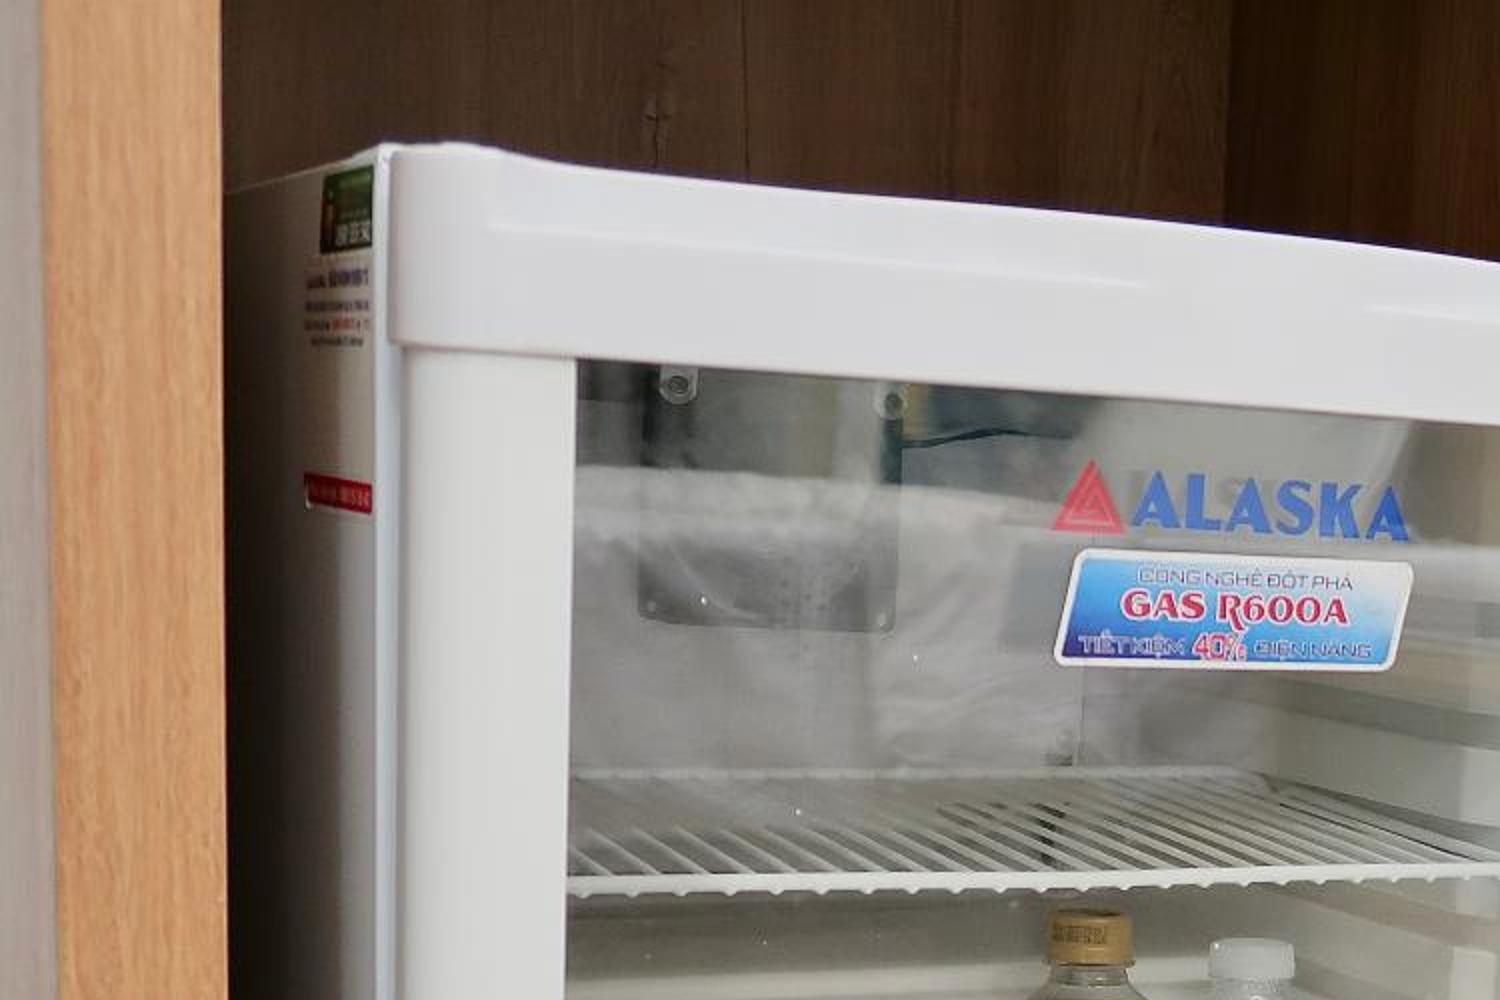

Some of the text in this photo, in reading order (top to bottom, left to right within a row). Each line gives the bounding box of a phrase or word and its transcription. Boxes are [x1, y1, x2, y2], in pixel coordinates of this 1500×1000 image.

[1131, 470, 1411, 543] ALASKA
[1123, 588, 1349, 631] GAS R600A
[1192, 632, 1248, 661] 40%
